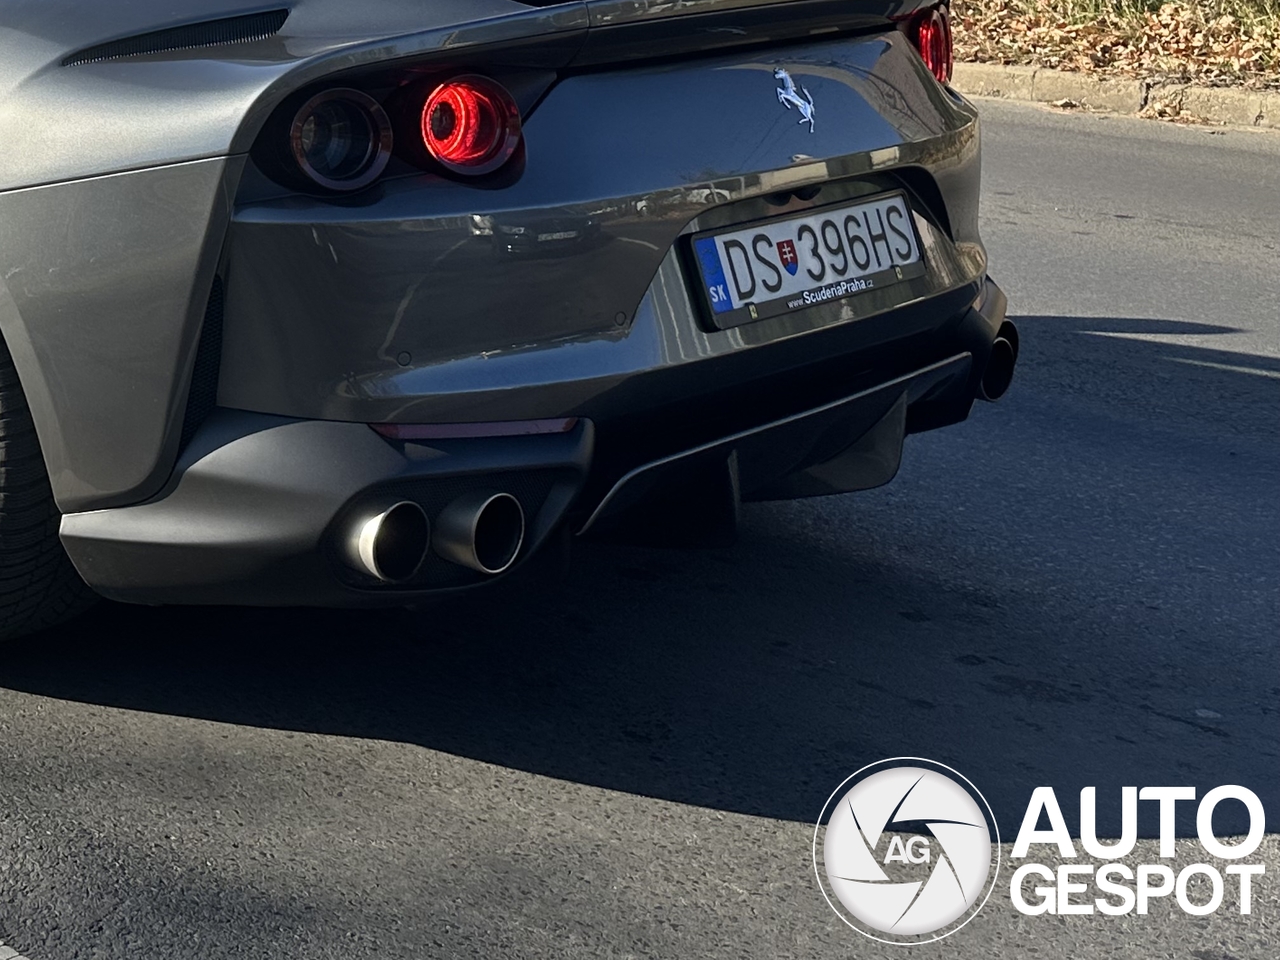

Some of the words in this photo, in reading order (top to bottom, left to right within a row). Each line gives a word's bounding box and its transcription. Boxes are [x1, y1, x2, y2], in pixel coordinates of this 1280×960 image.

[723, 233, 783, 301] DS
[797, 205, 913, 282] 396HS
[709, 284, 727, 303] SK
